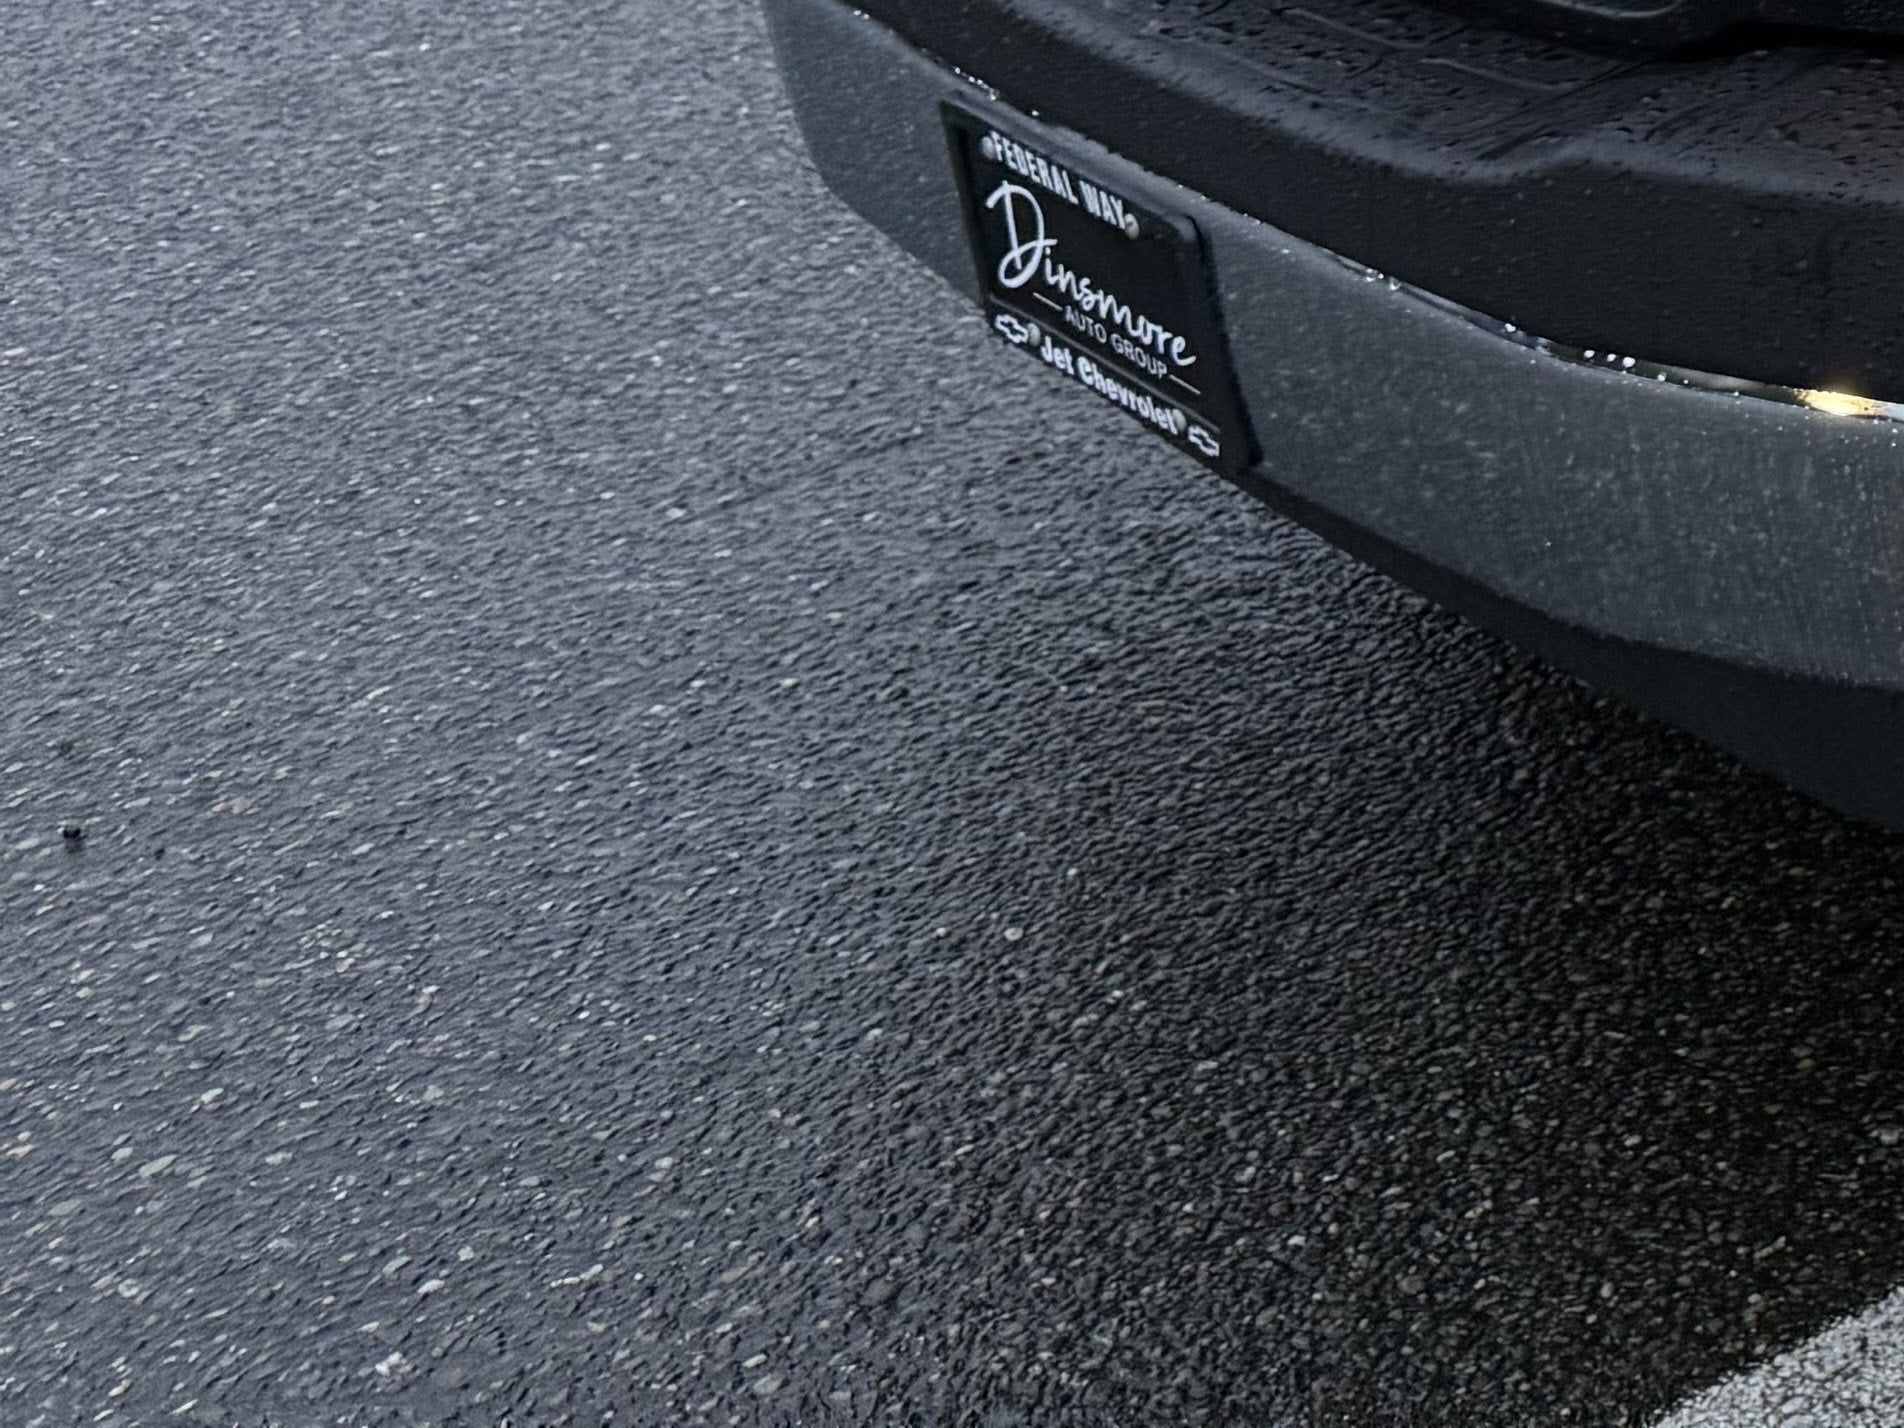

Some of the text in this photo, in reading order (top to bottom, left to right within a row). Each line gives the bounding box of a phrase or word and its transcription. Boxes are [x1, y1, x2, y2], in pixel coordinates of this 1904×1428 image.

[990, 130, 1126, 230] FEDERAL WAY
[985, 180, 1197, 366] Dinsmore
[1041, 335, 1179, 435] Jet Chevrolet
[1065, 305, 1168, 379] AUTO GROUP
